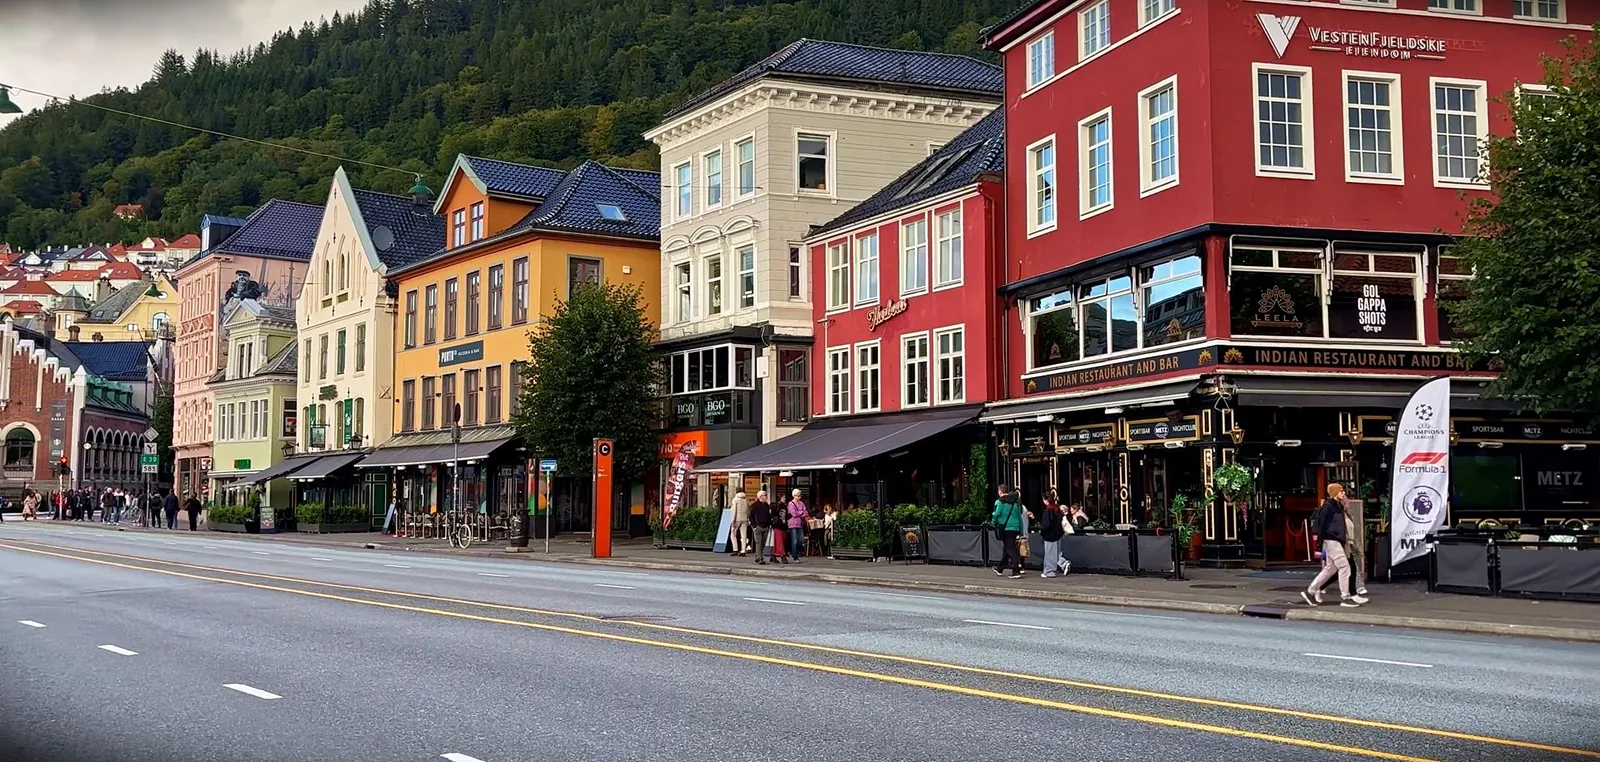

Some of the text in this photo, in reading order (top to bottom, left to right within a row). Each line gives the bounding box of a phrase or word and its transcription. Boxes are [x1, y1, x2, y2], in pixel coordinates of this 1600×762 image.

[1308, 27, 1446, 52] VESTENFJELDSKE
[1345, 46, 1411, 60] EIENDOM
[1363, 284, 1380, 298] GOL
[1357, 298, 1387, 312] GAPPA
[1254, 313, 1299, 322] LEELA
[1358, 311, 1386, 325] SHOTS
[1255, 350, 1308, 364] INDIAN
[1314, 352, 1406, 367] RESTAURANT
[1411, 354, 1442, 368] AND
[1050, 356, 1179, 388] INDIAN RESTAURANT AND BAR
[677, 403, 694, 414] BGO
[707, 400, 725, 411] BGO
[1130, 427, 1150, 435] SPORTSBAR
[1472, 425, 1504, 433] SPORTSBAR
[601, 445, 608, 454] C
[1399, 465, 1447, 474] Formula 1
[1537, 471, 1583, 486] METZ
